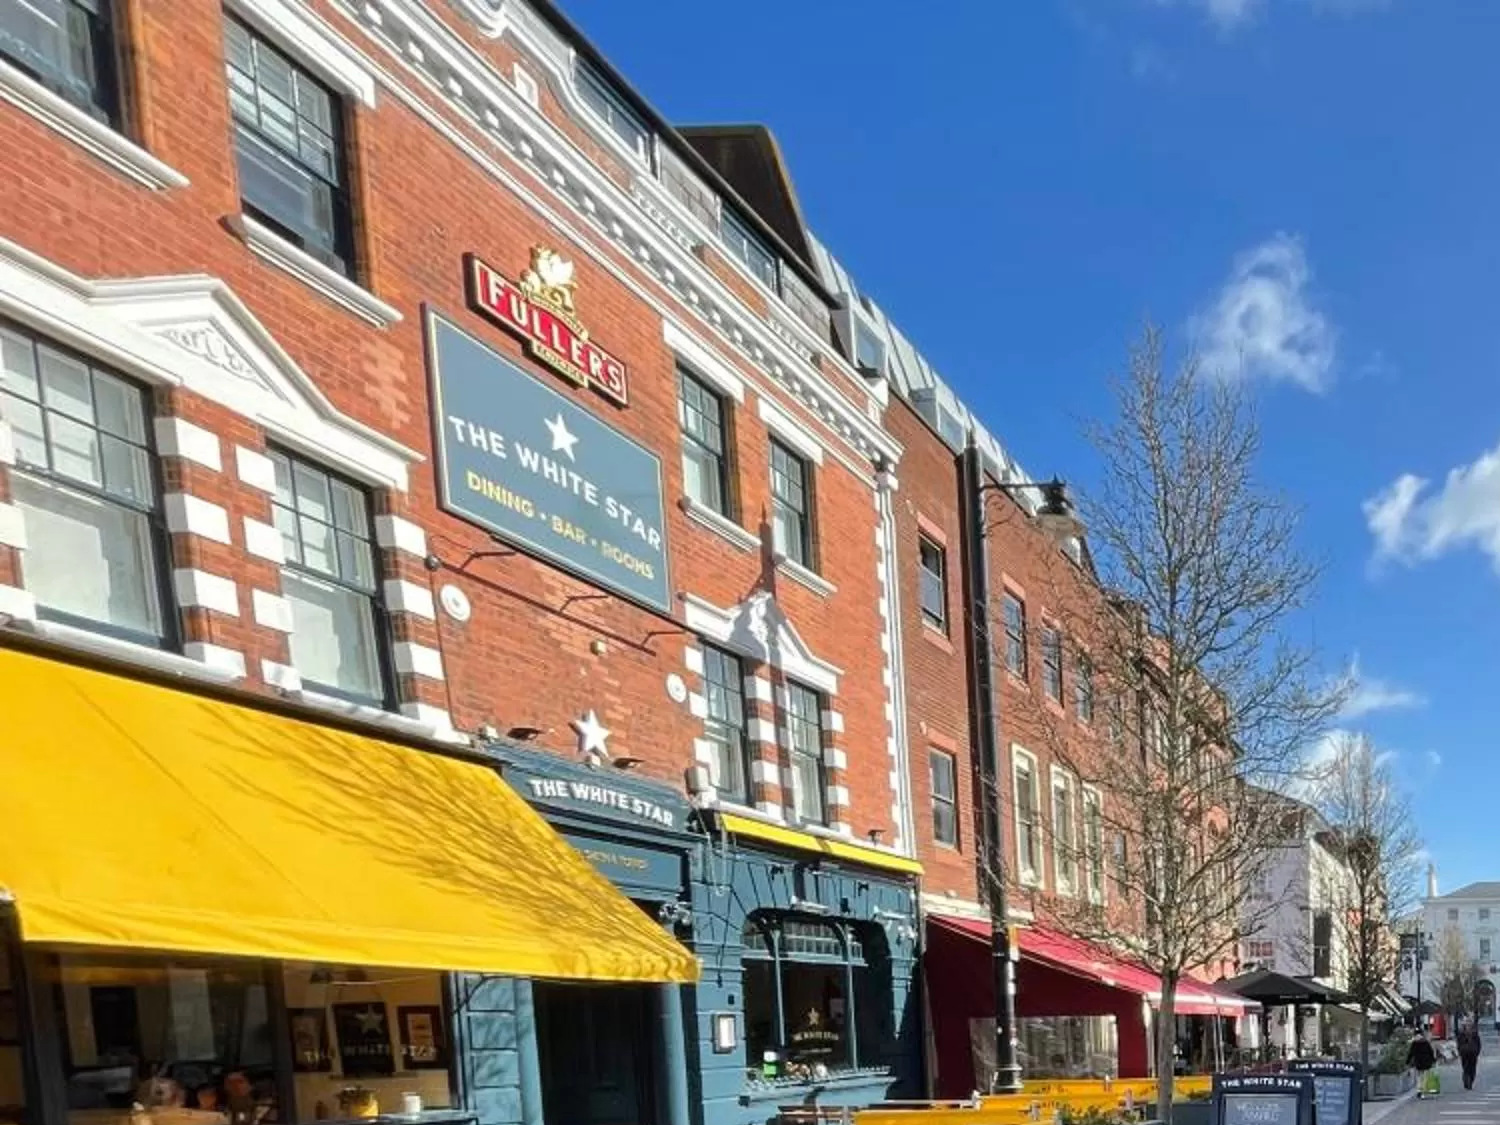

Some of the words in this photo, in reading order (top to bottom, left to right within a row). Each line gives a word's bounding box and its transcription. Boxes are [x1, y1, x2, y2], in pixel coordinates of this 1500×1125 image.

[487, 267, 621, 392] FULLER'S
[448, 415, 507, 459] THE
[515, 442, 599, 506] WHITE
[605, 496, 661, 551] STAR
[465, 469, 535, 518] DINING
[551, 514, 587, 545] BAR
[601, 541, 655, 580] ROOMS
[529, 779, 568, 797] THE
[570, 782, 629, 809] WHITE
[630, 799, 673, 827] STAR
[1243, 1077, 1274, 1086] WHITE
[1277, 1079, 1302, 1088] STAR
